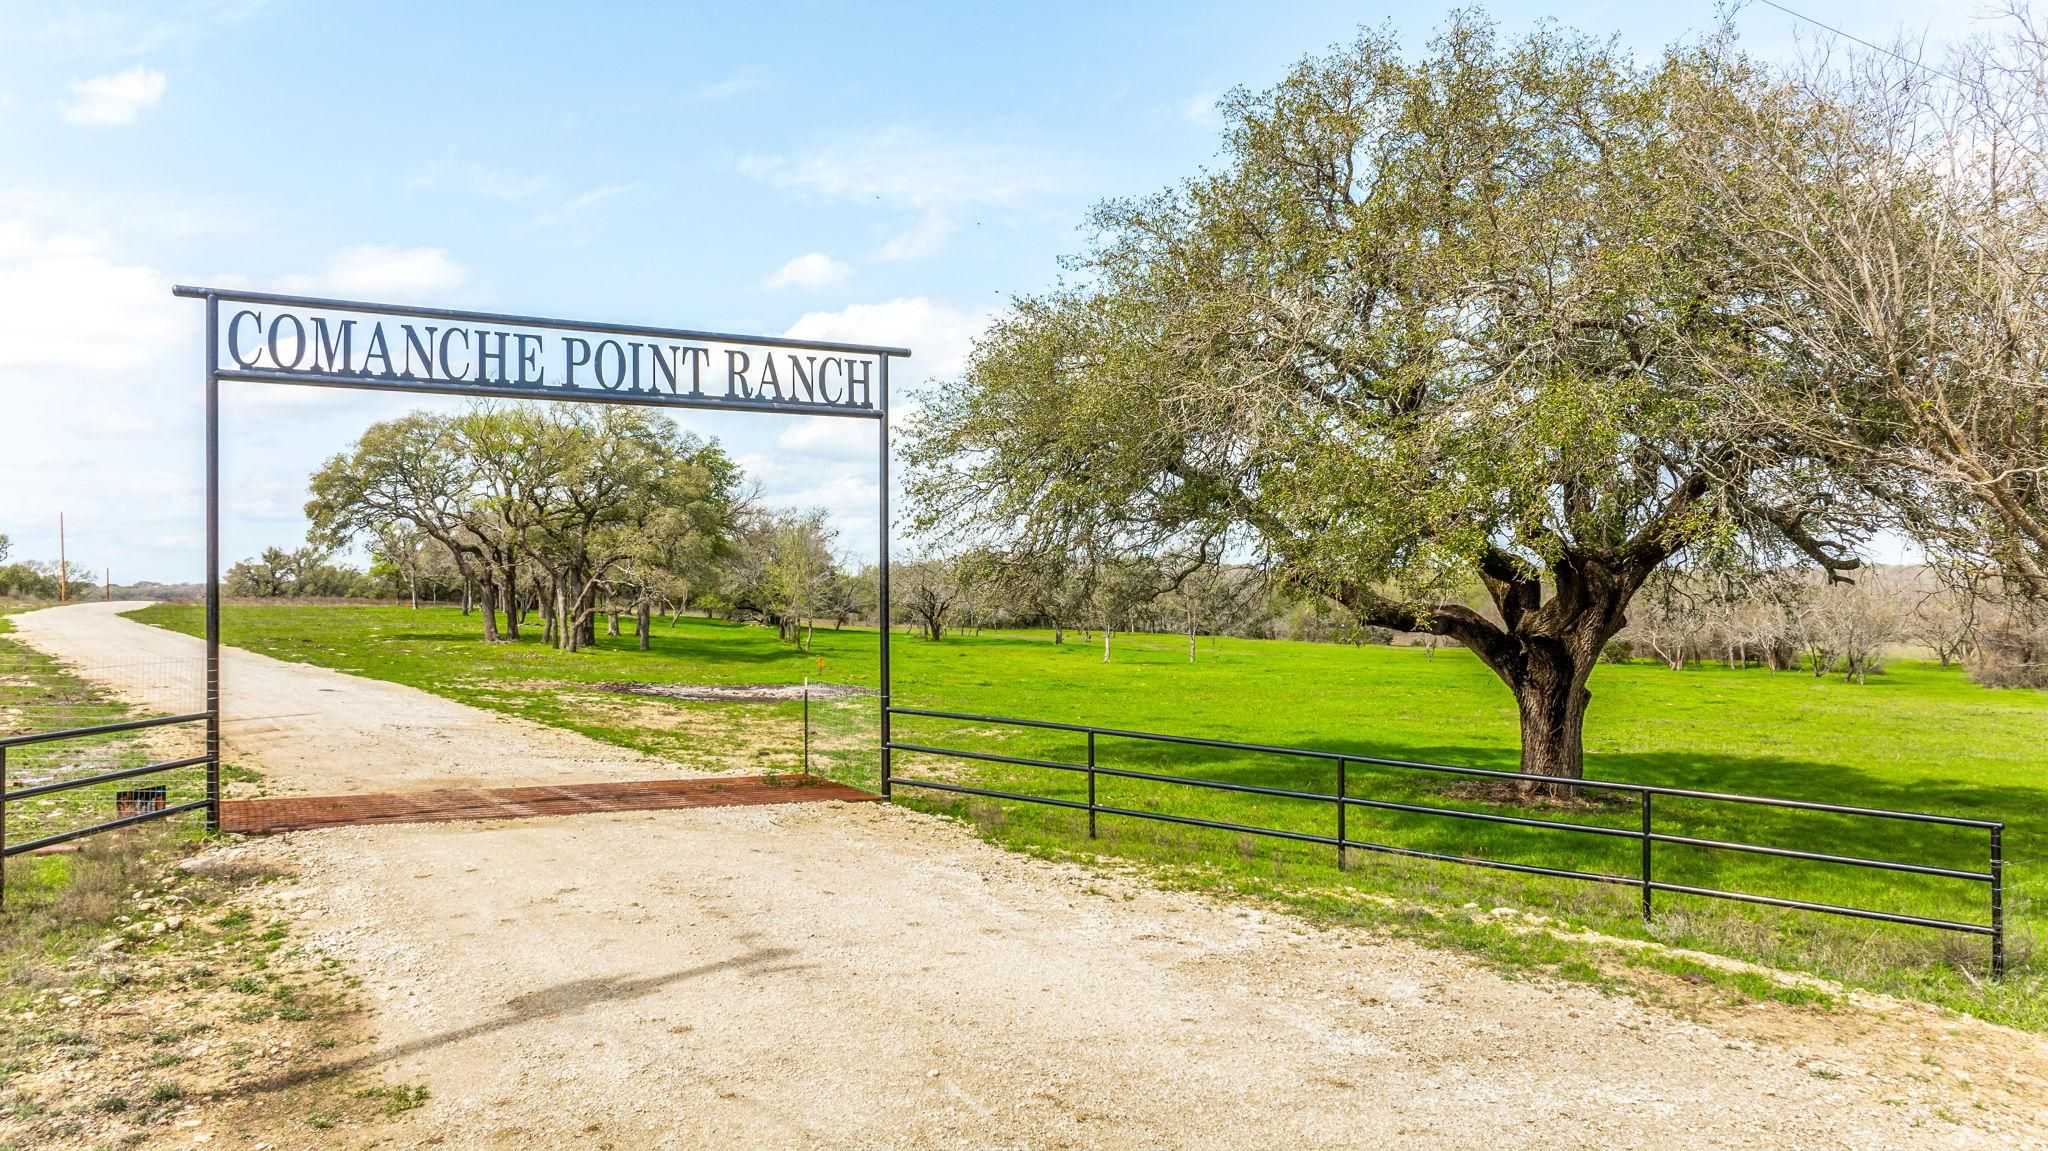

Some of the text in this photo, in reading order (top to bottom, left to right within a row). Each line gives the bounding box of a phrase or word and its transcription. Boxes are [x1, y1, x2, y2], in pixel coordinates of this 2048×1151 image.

[228, 310, 873, 409] COMANCHE POINT RANCH
